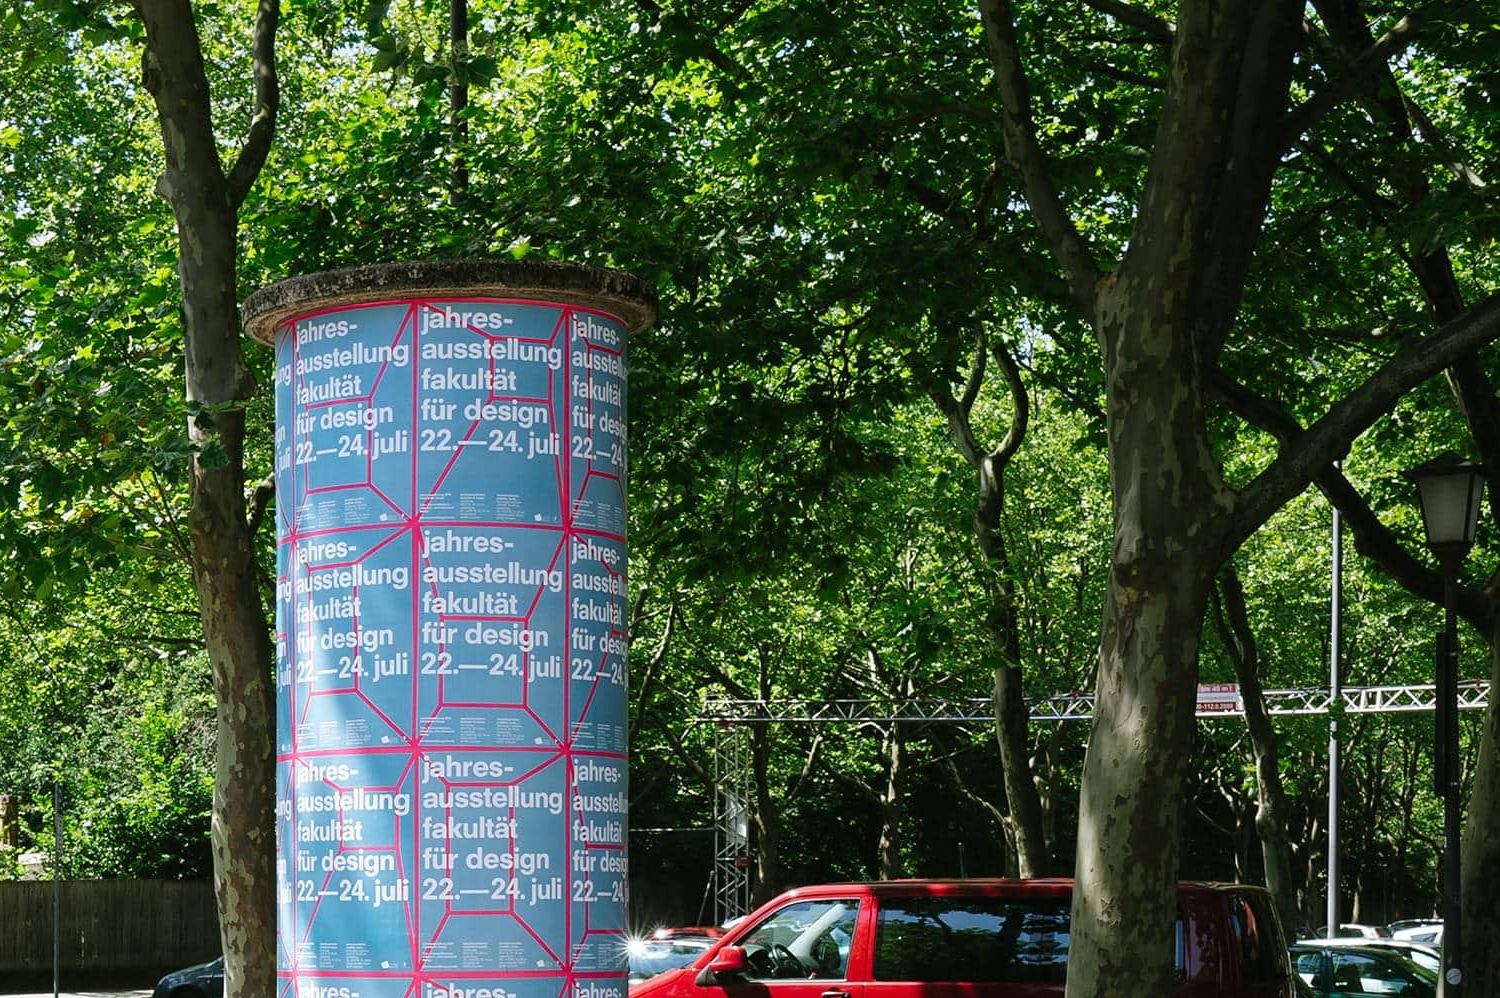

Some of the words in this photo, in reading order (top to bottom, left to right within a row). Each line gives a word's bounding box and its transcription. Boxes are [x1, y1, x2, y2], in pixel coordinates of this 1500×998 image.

[421, 306, 513, 335] jahres-
[572, 313, 620, 345] jahres-
[295, 320, 357, 352] jahres-
[296, 343, 409, 375] ausstellung
[422, 338, 562, 370] ausstellung
[296, 375, 362, 405] fakultät
[421, 368, 517, 391] fakultät
[296, 412, 316, 435] für
[320, 404, 393, 431] design
[421, 399, 457, 421] für
[464, 398, 548, 428] design
[572, 405, 596, 429] für
[372, 430, 408, 460] juli
[527, 431, 560, 460] juli
[296, 541, 357, 570] jahres-
[422, 530, 514, 559] jahres-
[572, 536, 620, 564] jahres-
[296, 565, 408, 593] ausstellung
[423, 561, 562, 592] ausstellung
[297, 596, 361, 624] fakultät
[422, 591, 518, 615] fakultät
[321, 628, 393, 652] design
[422, 622, 457, 645] für
[465, 622, 548, 652] design
[572, 628, 596, 651] für
[373, 653, 408, 683] juli
[528, 654, 560, 683] juli
[296, 761, 358, 789] jahres-
[422, 755, 514, 784] jahres-
[572, 758, 621, 786] jahres-
[297, 788, 410, 816] ausstellung
[423, 785, 563, 815] ausstellung
[298, 820, 362, 842] fakultät
[422, 816, 518, 839] fakultät
[321, 849, 394, 877] design
[422, 847, 459, 870] für
[466, 847, 550, 876] design
[572, 849, 597, 872] für
[373, 879, 409, 907] juli
[530, 877, 563, 906] juli
